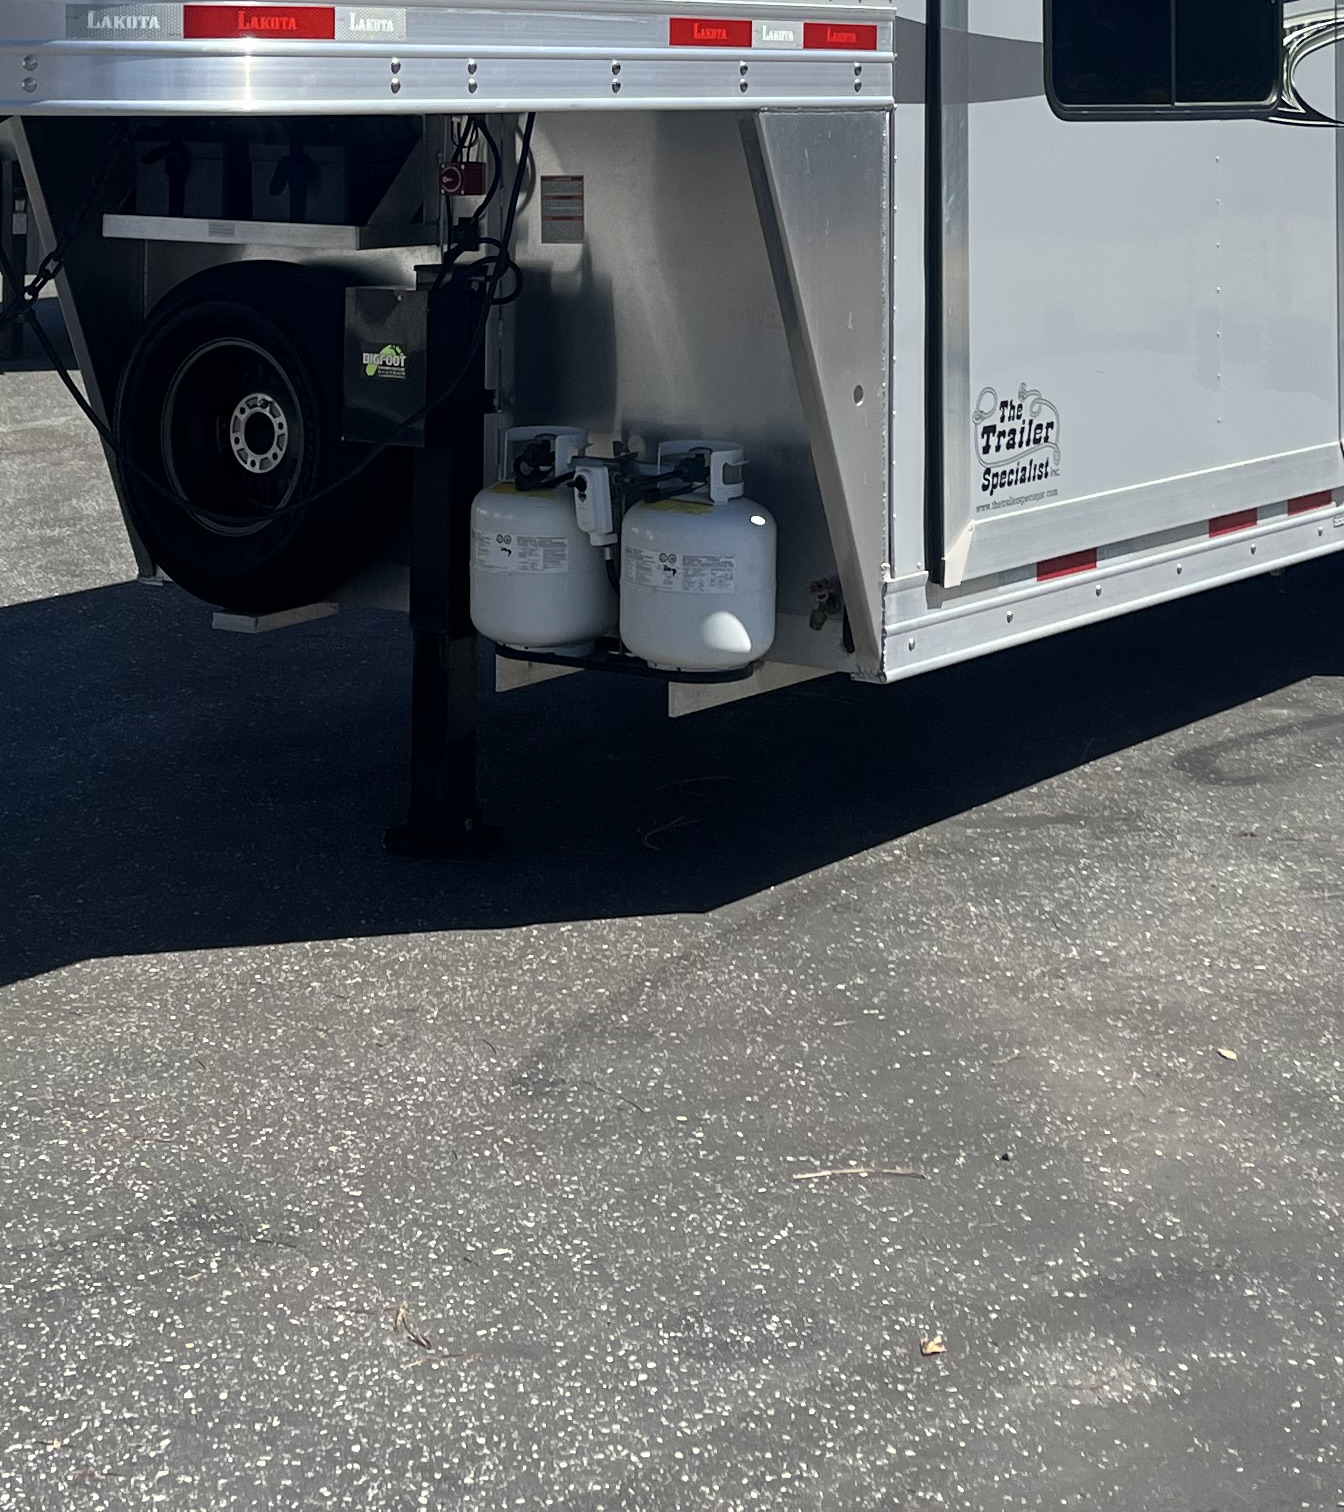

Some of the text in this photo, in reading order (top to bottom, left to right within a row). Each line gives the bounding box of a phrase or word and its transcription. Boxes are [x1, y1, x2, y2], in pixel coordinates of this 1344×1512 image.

[86, 10, 395, 32] LAKOTA LAKOTA LAKOTA
[362, 352, 406, 366] BIGFOOT
[999, 399, 1023, 423] The
[981, 419, 1054, 455] Trailer
[981, 456, 1049, 496] Specialist
